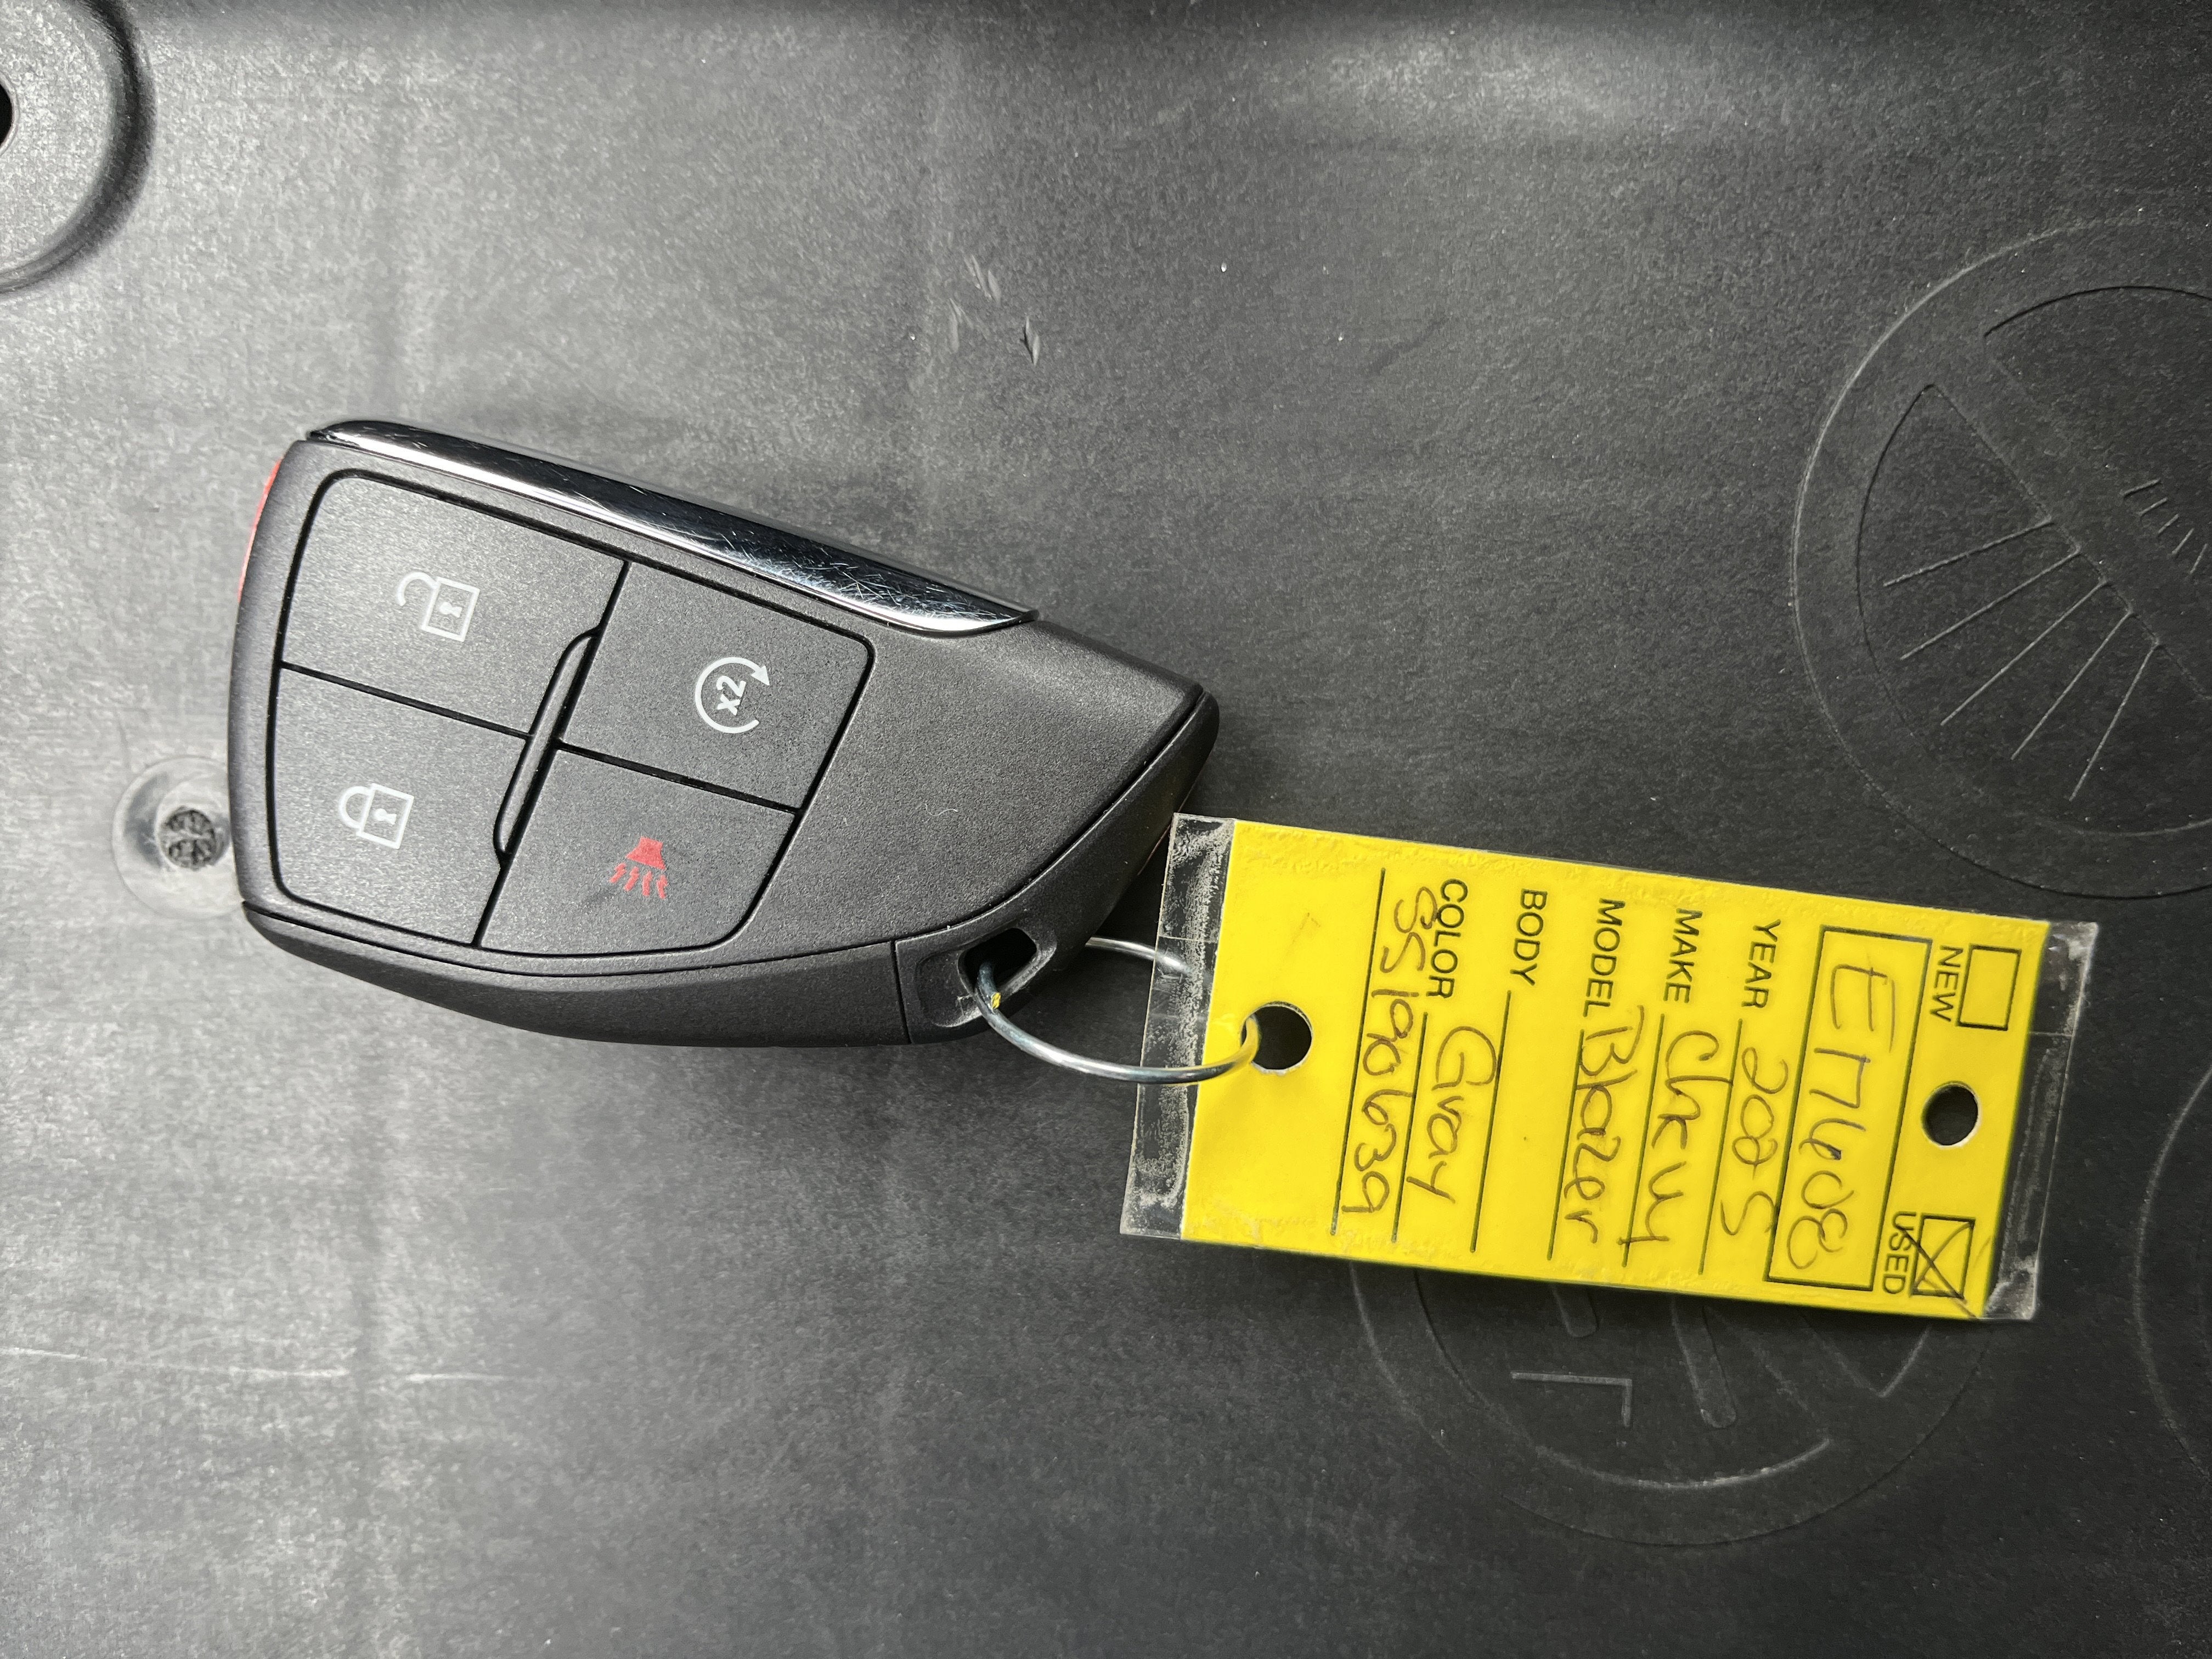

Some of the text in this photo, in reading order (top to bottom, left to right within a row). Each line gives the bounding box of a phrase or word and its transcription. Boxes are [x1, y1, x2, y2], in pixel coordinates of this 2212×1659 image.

[716, 675, 747, 716] x2
[1426, 879, 1468, 999] COLOR
[1510, 890, 1548, 986] BODY
[1583, 899, 1625, 1018] MODEL
[1663, 907, 1703, 1005] MAKE
[1742, 918, 1781, 1009] YEAR
[1929, 945, 1963, 1023] NEW
[1563, 1005, 1645, 1244] Blazer
[1720, 1047, 1788, 1237] 2025
[1882, 1211, 1917, 1294] USED
